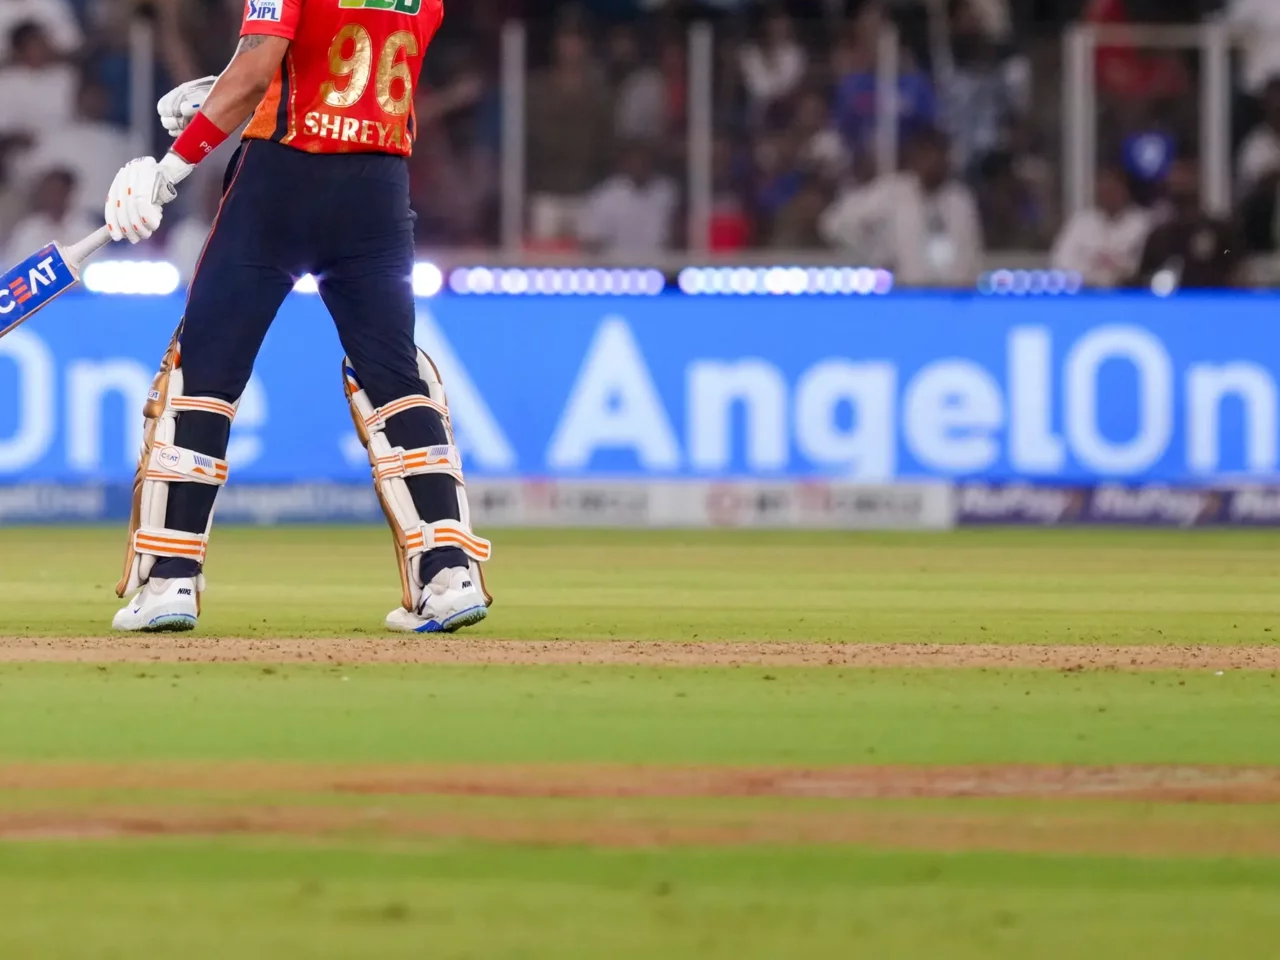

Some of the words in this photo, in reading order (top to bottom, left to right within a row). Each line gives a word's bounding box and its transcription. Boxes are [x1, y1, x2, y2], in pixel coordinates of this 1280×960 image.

[257, 7, 279, 20] IPL
[320, 23, 419, 116] 96
[161, 452, 179, 462] CEAT
[177, 587, 192, 596] NIKE
